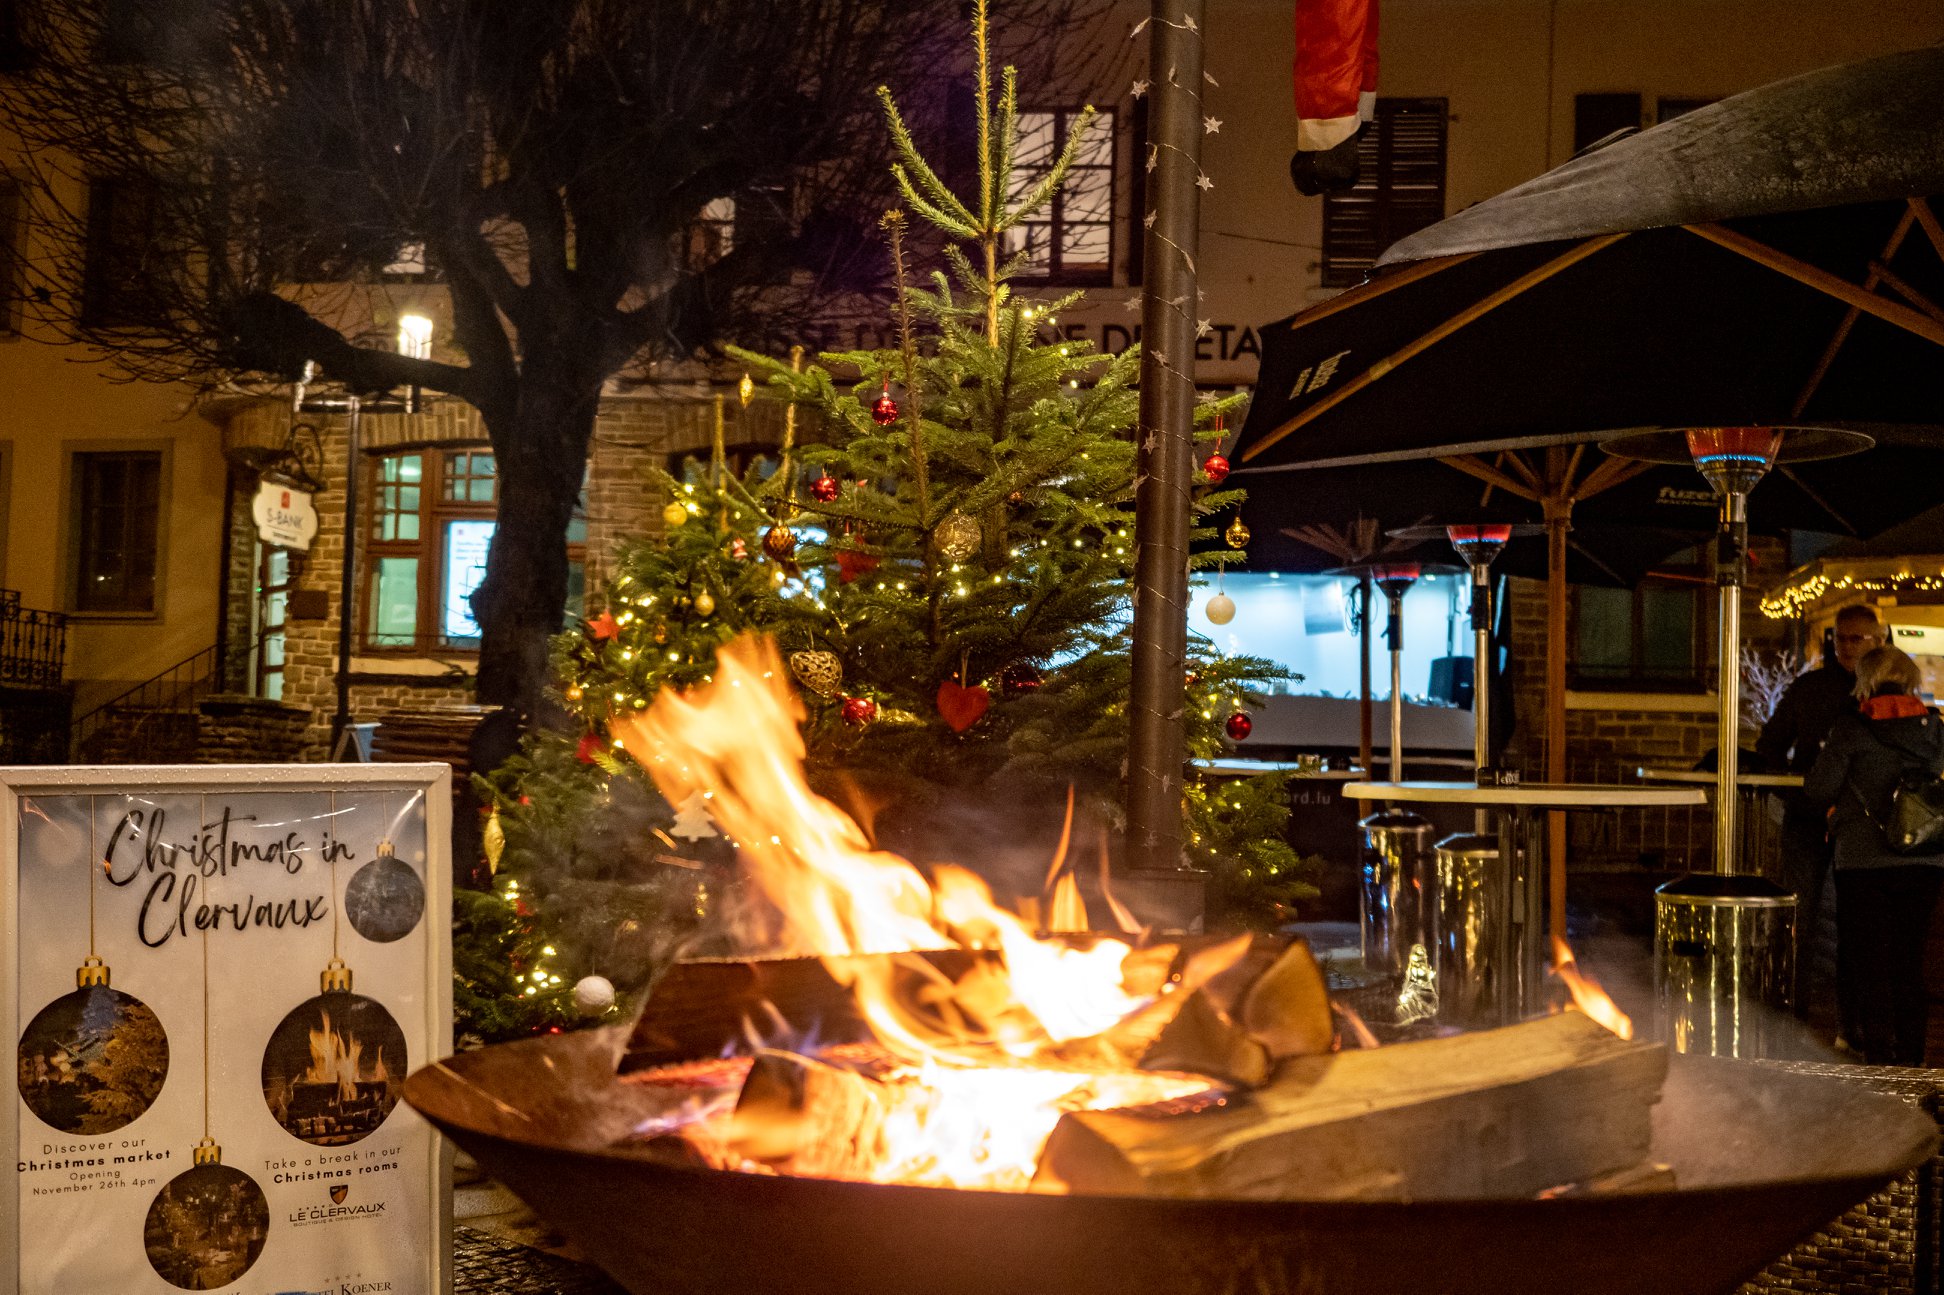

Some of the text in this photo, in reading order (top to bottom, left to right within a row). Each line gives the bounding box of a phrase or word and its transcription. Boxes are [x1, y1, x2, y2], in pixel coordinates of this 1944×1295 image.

[1194, 324, 1262, 361] ETA
[104, 806, 356, 886] Christmas in
[138, 871, 329, 948] Clervaux
[43, 1138, 146, 1155] Discover our
[17, 1150, 171, 1173] Christmas market
[264, 1146, 401, 1171] Take a break in our
[69, 1170, 121, 1182] Opening
[273, 1162, 398, 1184] Christmas rooms
[33, 1177, 156, 1196] November 26th 4pm
[289, 1202, 386, 1222] LE CLERVAUX
[293, 1219, 327, 1227] BOUTIQUE
[340, 1282, 392, 1295] KOENER
